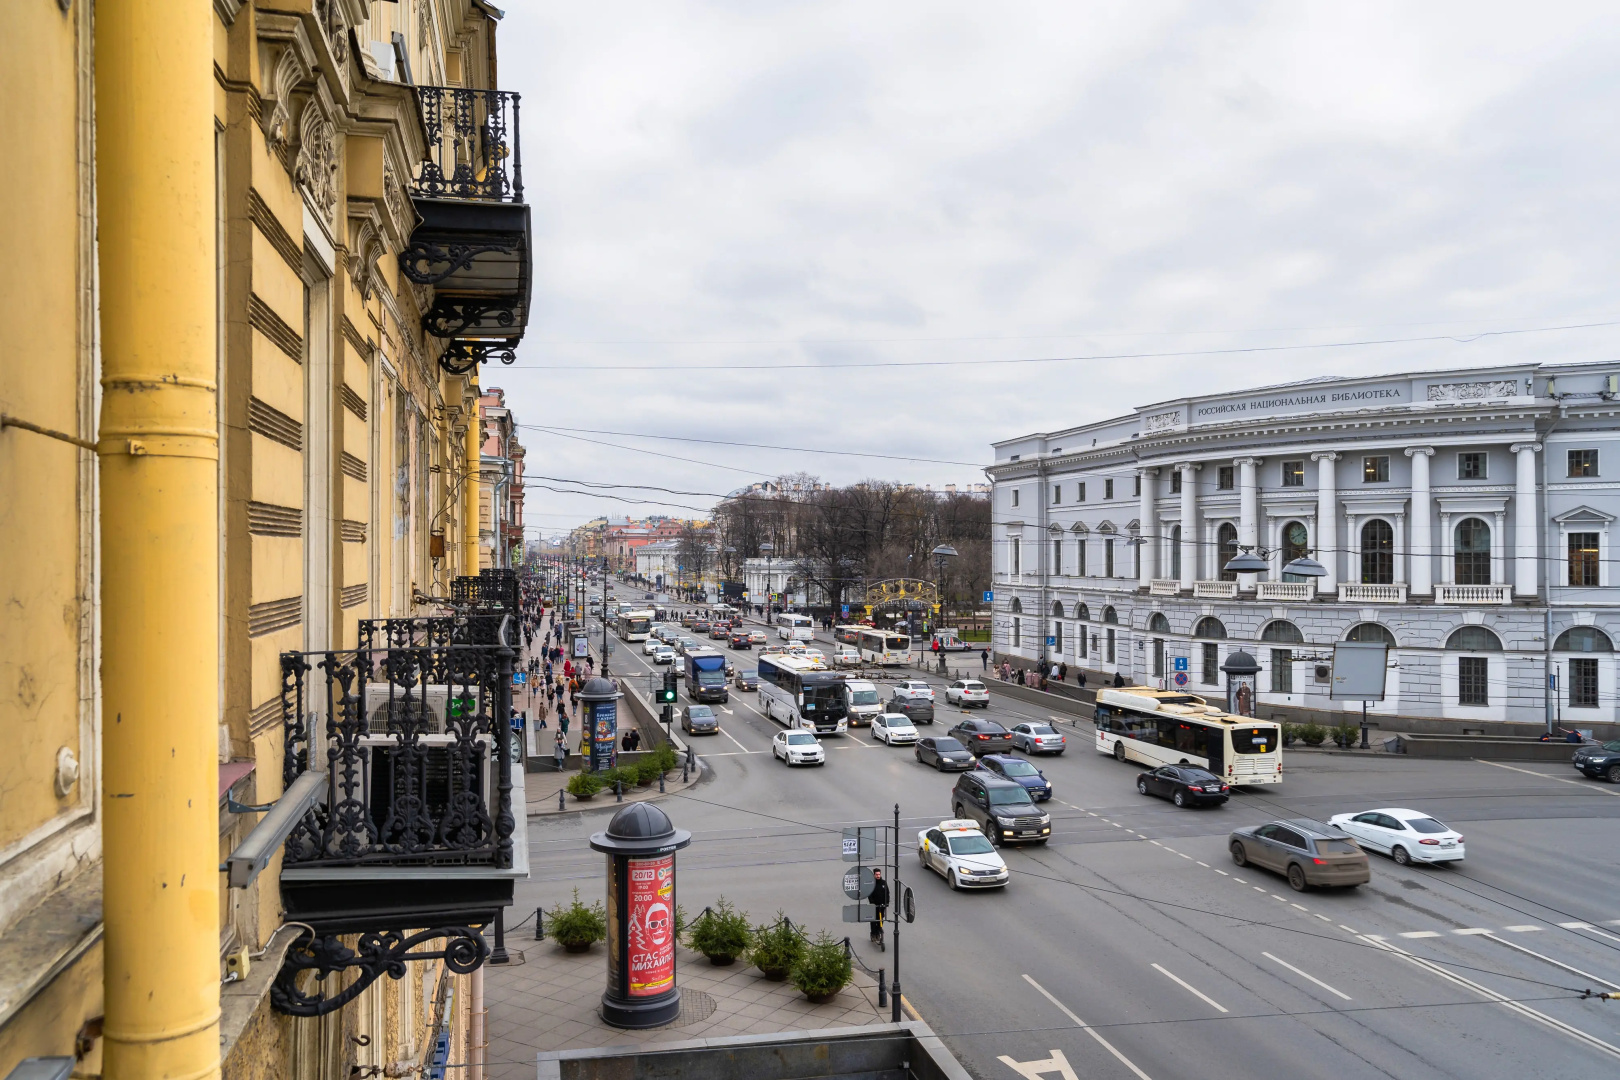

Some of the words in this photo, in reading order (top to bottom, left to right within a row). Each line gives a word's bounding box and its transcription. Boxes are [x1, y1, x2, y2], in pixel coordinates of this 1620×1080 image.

[1198, 403, 1246, 416] РОССИЙСКАЯ
[1250, 394, 1326, 410] НАЦИОНАЛЬНАЯ
[1331, 388, 1401, 402] БИБЛИОТЕКА
[634, 871, 653, 879] 20/12
[634, 894, 653, 902] 20.00
[631, 951, 674, 971] МИХАЙЛО
[632, 951, 659, 963] СТАС
